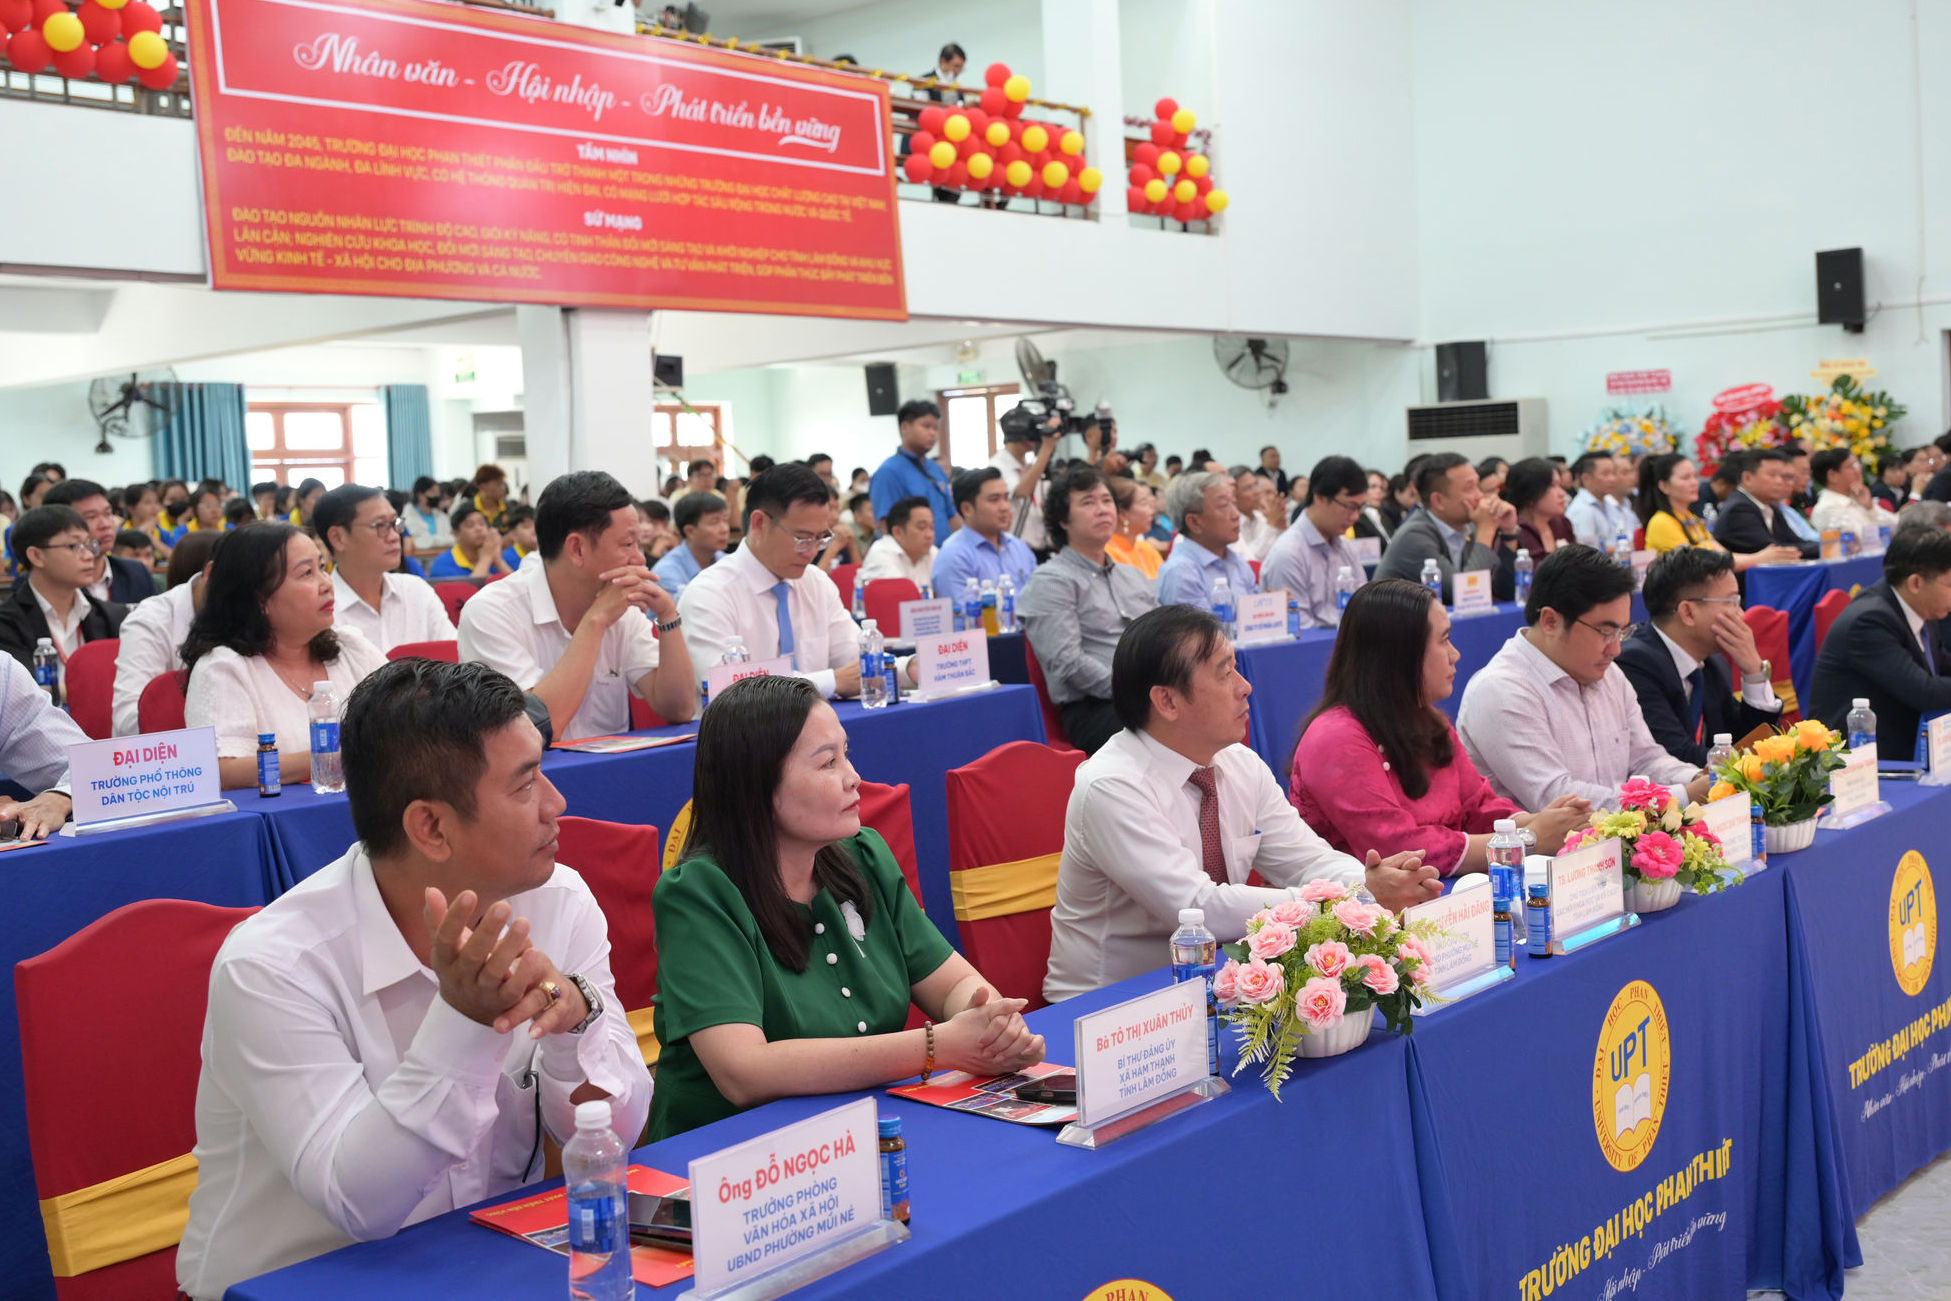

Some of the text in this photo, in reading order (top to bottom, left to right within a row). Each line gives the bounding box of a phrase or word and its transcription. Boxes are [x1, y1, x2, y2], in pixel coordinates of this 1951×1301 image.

[293, 33, 401, 79] Nhân
[404, 60, 459, 87] văn
[485, 61, 552, 104] Hội
[553, 74, 616, 121] nhập
[640, 83, 708, 121] Phát
[710, 101, 755, 129] triển
[778, 118, 841, 153] vững
[938, 639, 968, 657] ĐẠI DIỆN
[113, 742, 178, 768] ĐẠI DIỆN
[91, 766, 202, 791] TRƯỜNG PHỔ THÔNG
[101, 781, 195, 806] DÂN TỘC NỘI TRÚ
[1604, 857, 1616, 870] SƠN
[1899, 878, 1922, 926] UPT
[1629, 985, 1648, 1001] PHAN
[1096, 1002, 1194, 1053] Bà TÔ THỊ XUÂN THỦY
[1117, 1056, 1126, 1070] BÍ
[1127, 1050, 1143, 1067] THƯ
[1143, 1043, 1164, 1060] ĐẢNG
[1610, 1015, 1650, 1082] UPT
[1848, 1039, 1892, 1090] TRƯỜNG
[1892, 1025, 1910, 1061] ĐẠI
[1910, 1012, 1931, 1049] HỌC
[1118, 1067, 1177, 1099] TỈNH LÂM ĐỒNG
[1119, 1055, 1175, 1084] XÃ HÀM THẠNH
[1594, 1099, 1623, 1168] UNIVERSITY
[1627, 1151, 1640, 1168] OF
[1642, 1118, 1660, 1154] PHAN
[718, 1177, 752, 1203] Ông
[755, 1153, 780, 1190] ĐỖ
[783, 1144, 831, 1179] NGỌC
[796, 1177, 838, 1206] PHÒNG
[743, 1194, 839, 1245] VĂN HÓA XÃ HỘI
[1519, 1234, 1592, 1301] TRƯỜNG
[1593, 1212, 1620, 1261] ĐẠI
[1622, 1191, 1654, 1240] HỌC
[1656, 1162, 1693, 1217] PHAN
[727, 1247, 762, 1272] UBND
[764, 1226, 814, 1257] PHƯỜNG
